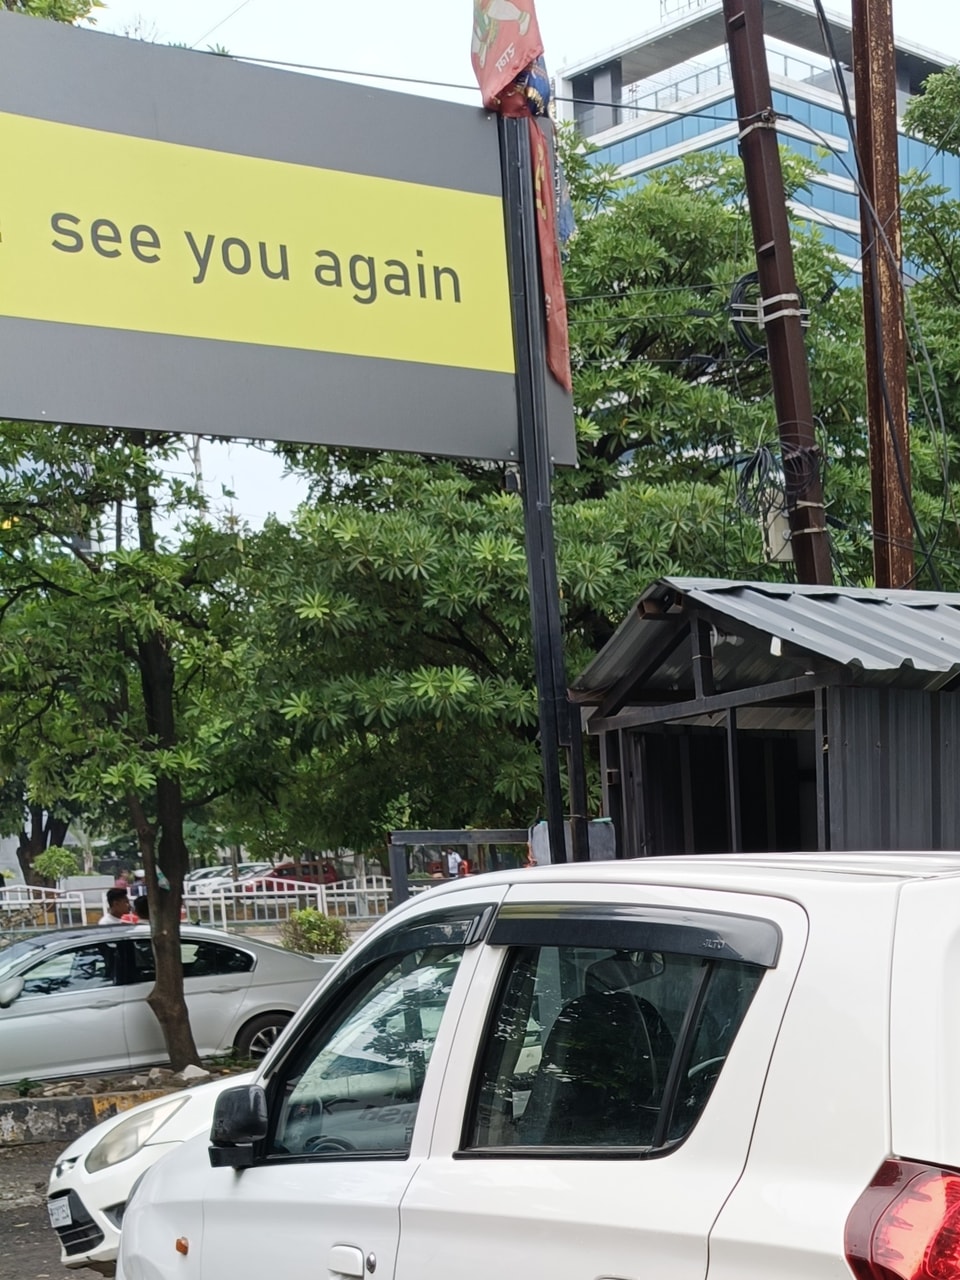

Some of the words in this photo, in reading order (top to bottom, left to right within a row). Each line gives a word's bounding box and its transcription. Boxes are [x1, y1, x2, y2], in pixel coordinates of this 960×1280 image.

[49, 212, 162, 264] see
[183, 230, 291, 285] you
[313, 249, 462, 306] again
